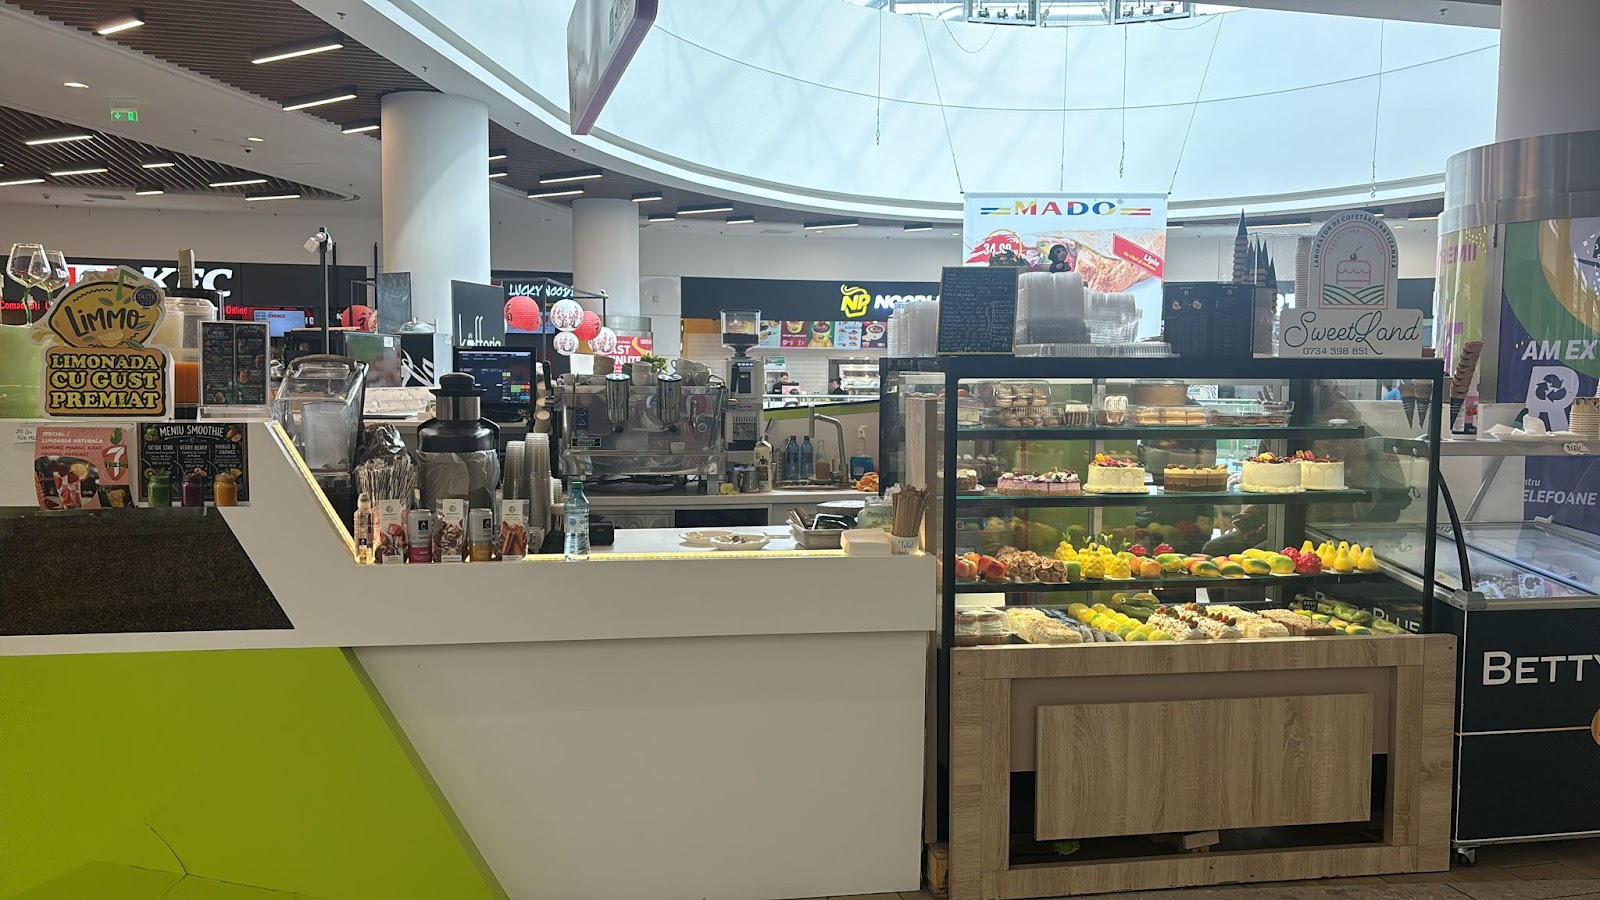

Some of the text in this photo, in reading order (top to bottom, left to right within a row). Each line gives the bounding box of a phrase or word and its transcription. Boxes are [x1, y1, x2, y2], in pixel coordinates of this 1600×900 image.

[1015, 201, 1116, 215] MADO
[1332, 219, 1340, 227] DE
[508, 284, 543, 297] LUCKY
[841, 294, 871, 311] NP
[226, 305, 248, 315] Online
[1302, 347, 1368, 355] 0734 398 851
[1521, 340, 1559, 360] AM
[50, 354, 158, 370] LIMONADA
[50, 371, 159, 390] CU GUST
[50, 391, 160, 409] PREMIAT
[160, 424, 225, 437] MENIU SMOOTHIE
